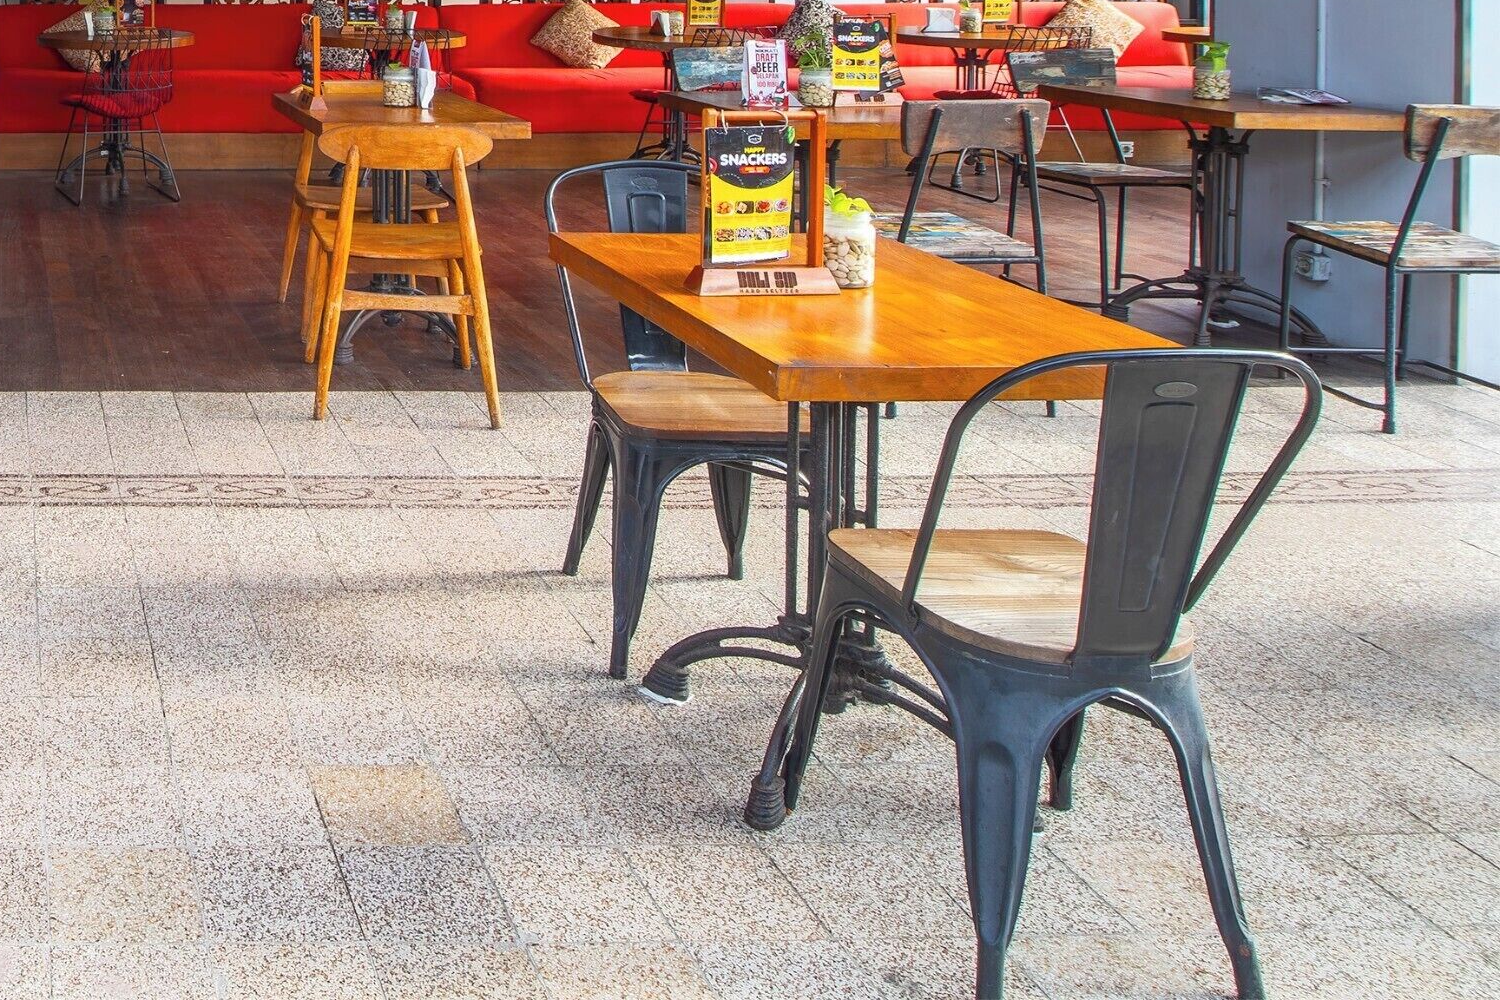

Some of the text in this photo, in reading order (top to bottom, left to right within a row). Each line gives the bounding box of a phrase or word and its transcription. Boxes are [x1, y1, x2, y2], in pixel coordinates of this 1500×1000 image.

[837, 34, 876, 43] SNACKERS
[755, 53, 778, 62] DRAFT
[756, 62, 779, 73] BEER
[720, 152, 788, 166] SNACKERS
